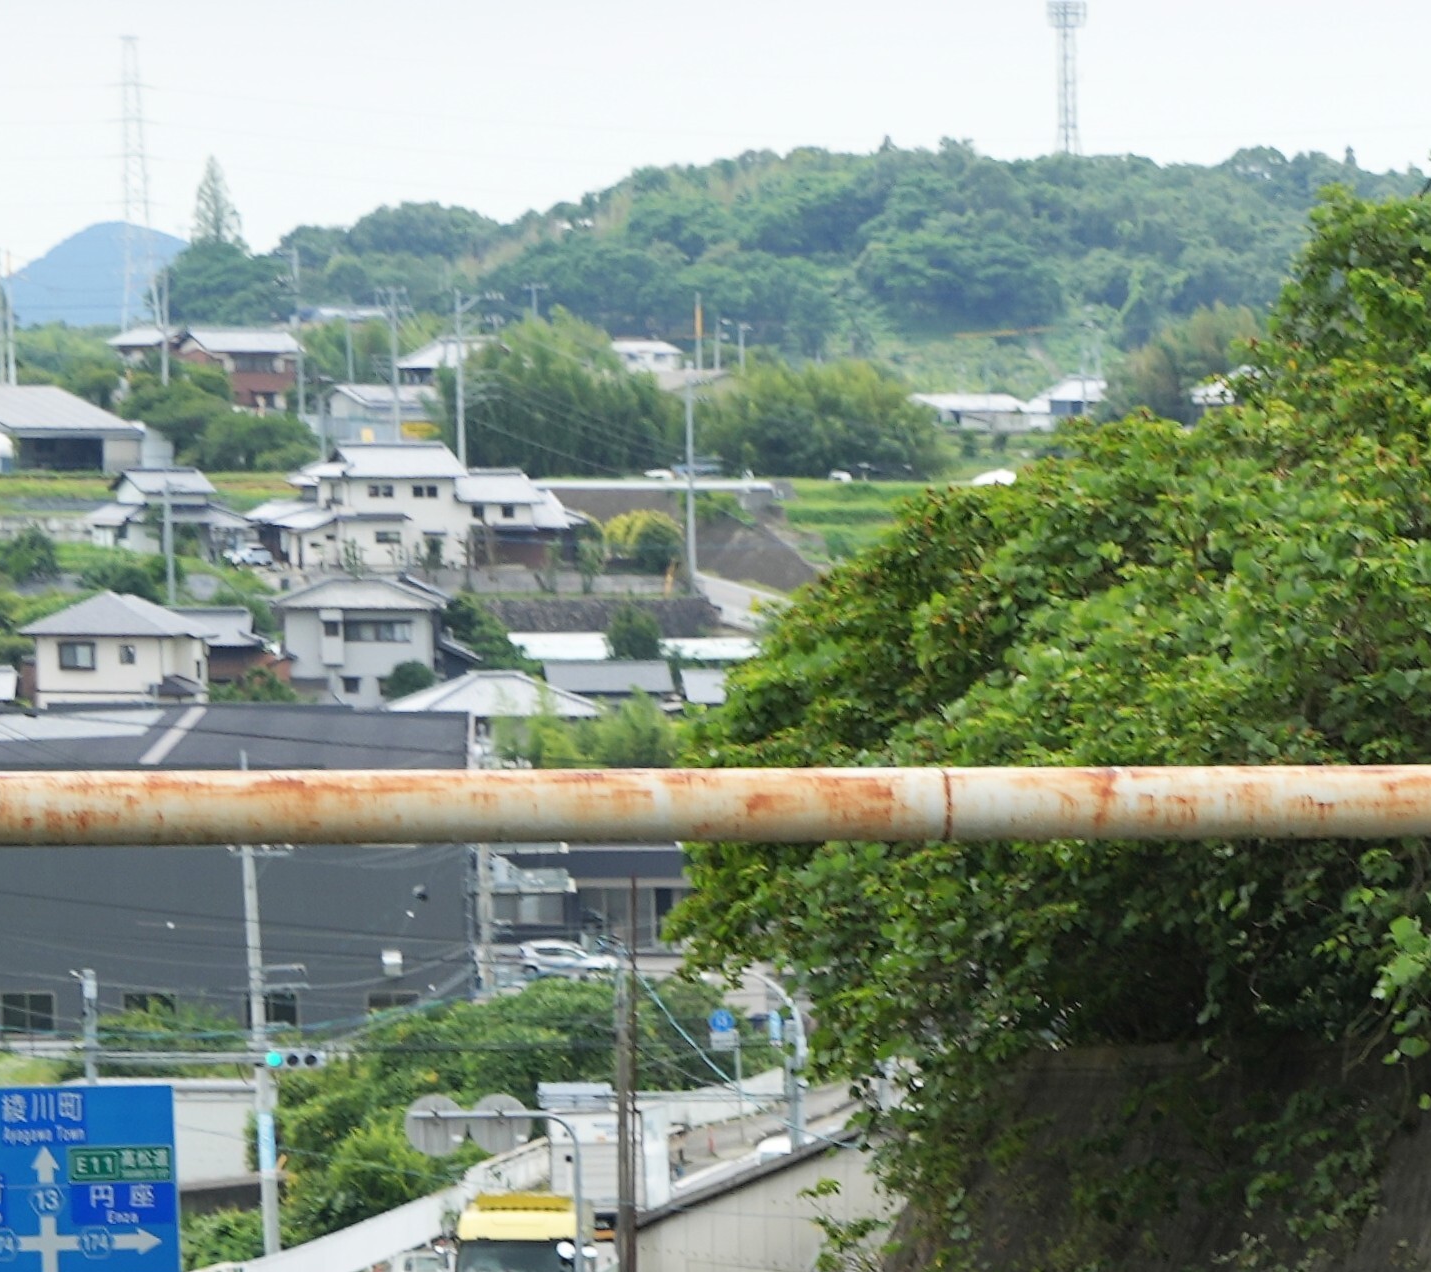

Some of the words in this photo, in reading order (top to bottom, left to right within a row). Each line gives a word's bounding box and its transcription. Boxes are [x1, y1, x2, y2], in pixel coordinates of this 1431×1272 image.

[75, 1156, 114, 1174] E11
[89, 1184, 155, 1208] 円座
[106, 1209, 139, 1224] Enza
[81, 1233, 109, 1251] 174
